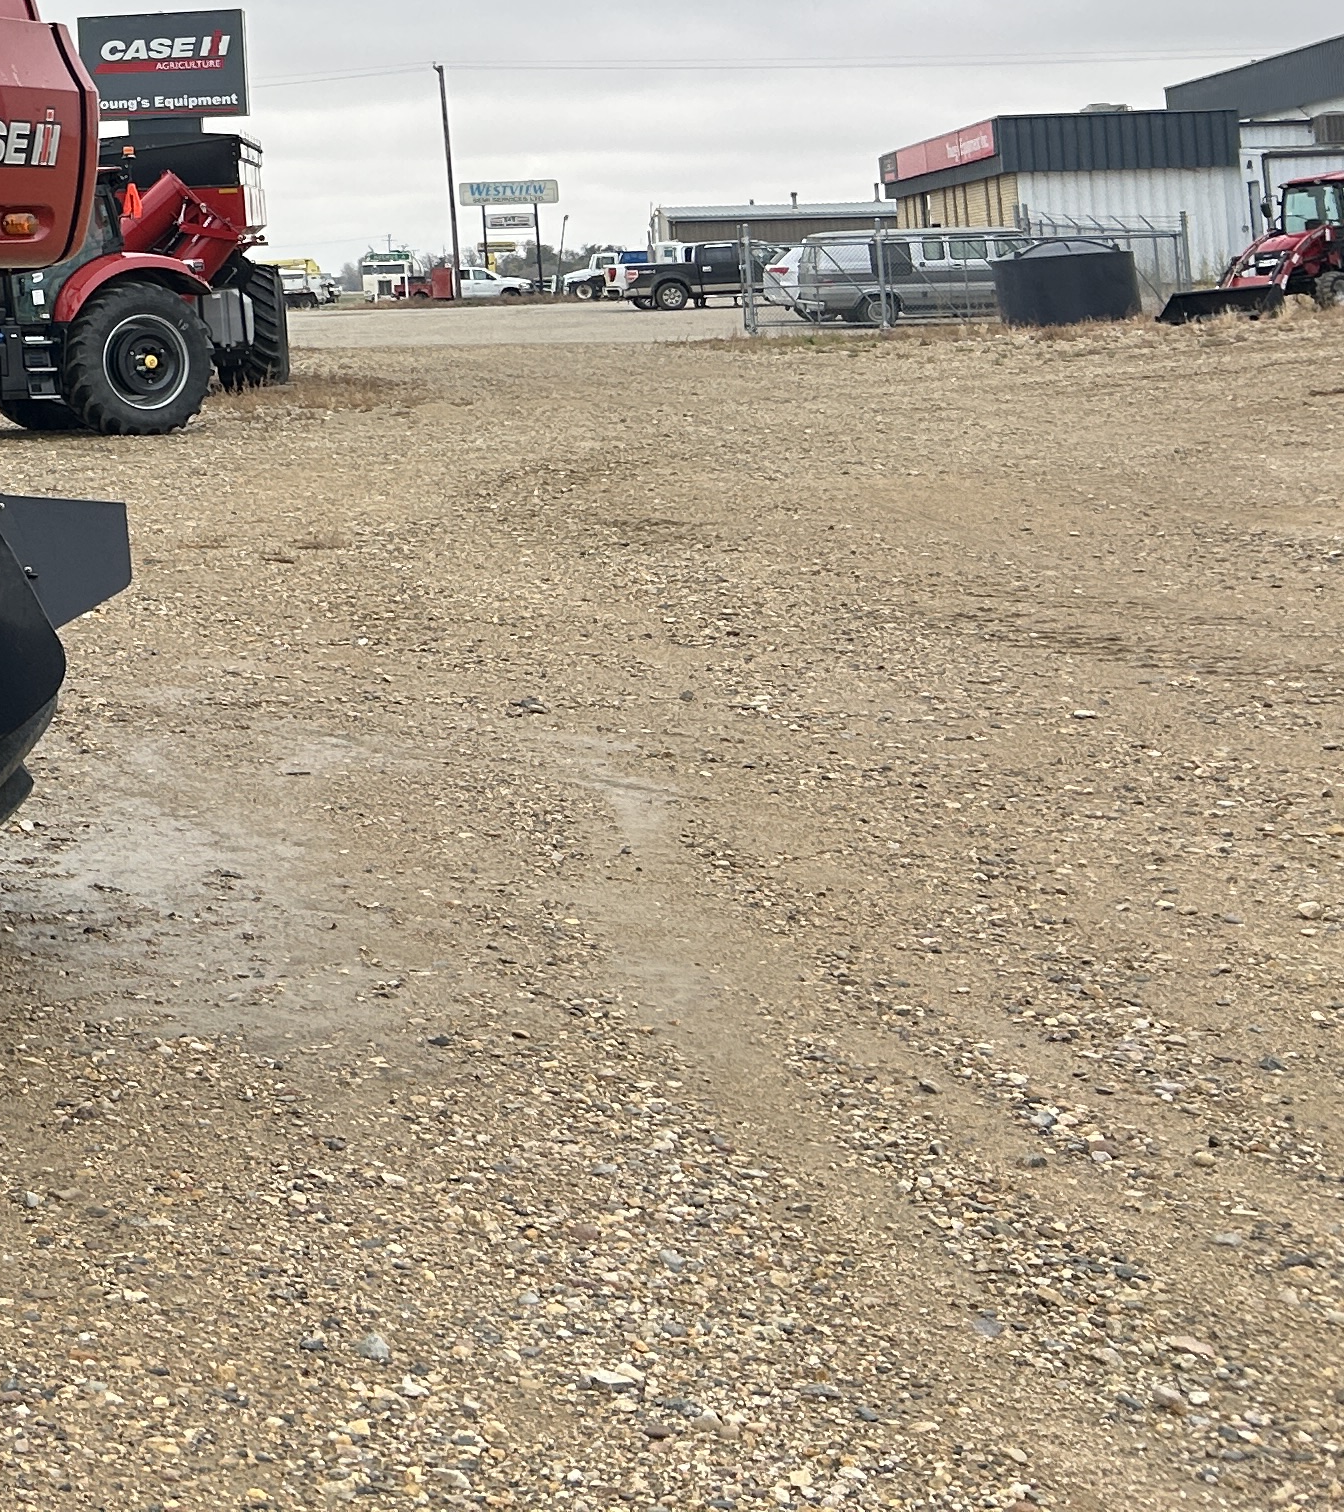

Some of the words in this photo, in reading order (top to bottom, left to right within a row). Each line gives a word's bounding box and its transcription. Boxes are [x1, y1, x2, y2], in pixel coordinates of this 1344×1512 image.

[100, 36, 196, 62] CASE
[155, 59, 222, 70] AGRICULTURE
[154, 92, 238, 109] Equipment
[469, 181, 546, 197] WESTVIEW
